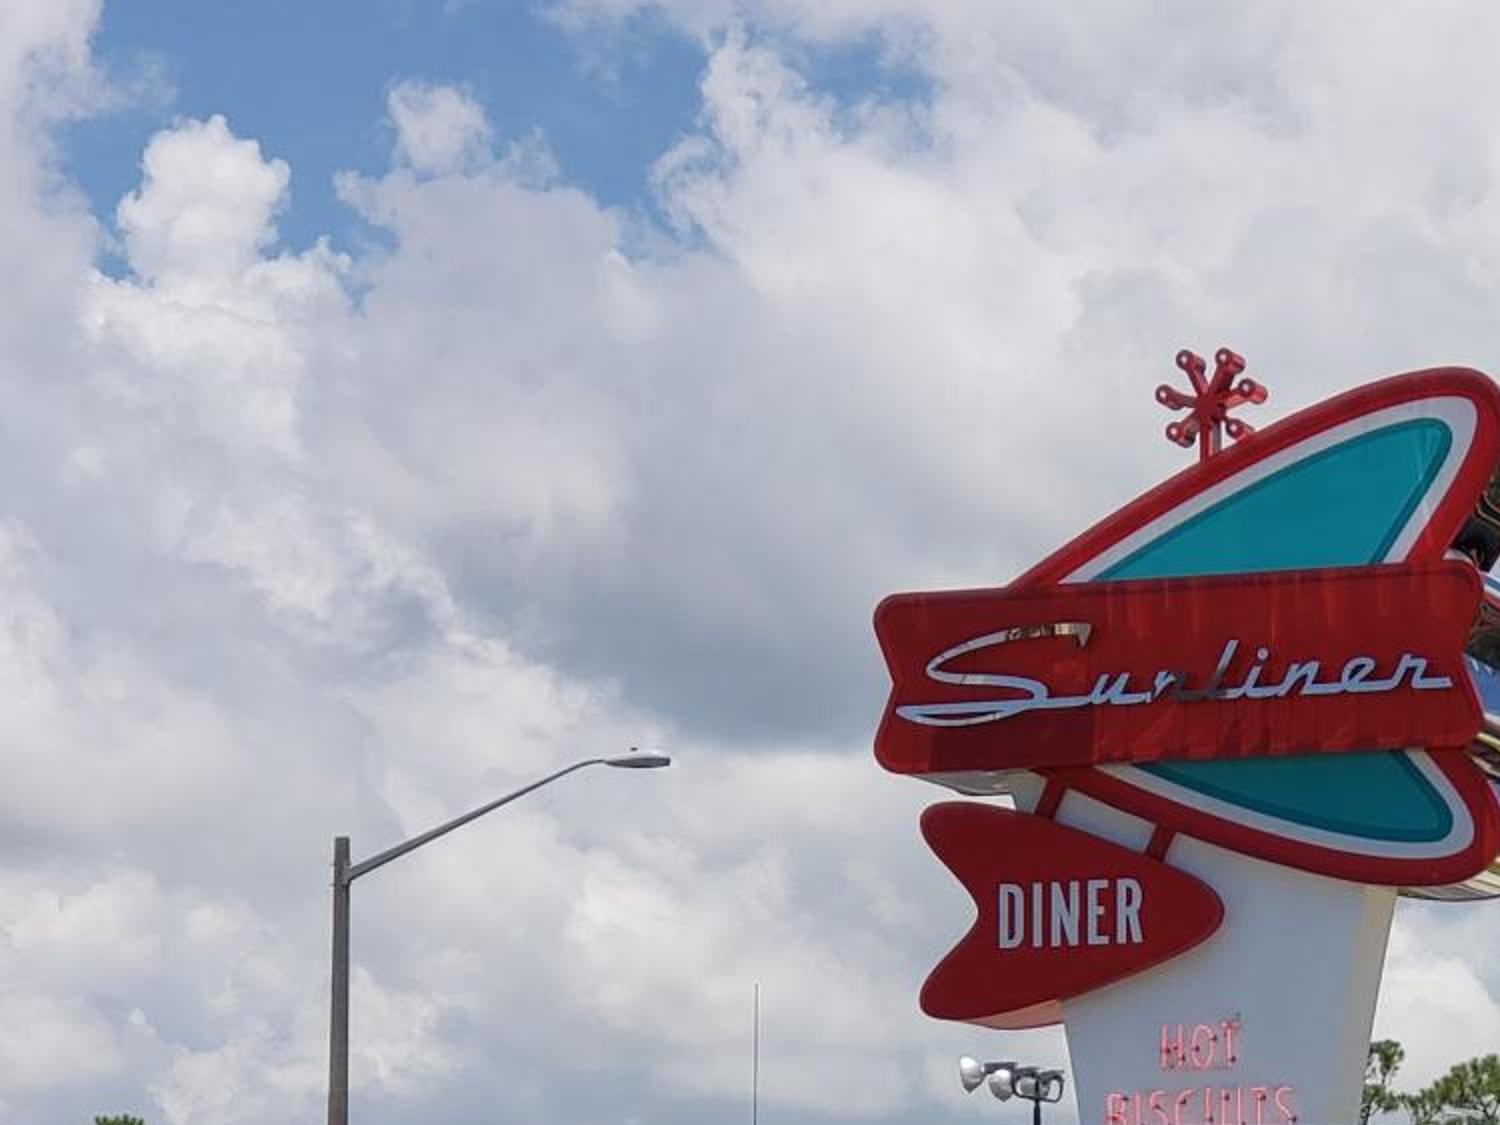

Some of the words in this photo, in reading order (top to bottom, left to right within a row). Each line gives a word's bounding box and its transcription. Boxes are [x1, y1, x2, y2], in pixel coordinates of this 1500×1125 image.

[896, 622, 1453, 727] Sunliner
[998, 877, 1144, 949] DINER
[1159, 1021, 1240, 1069] HOT
